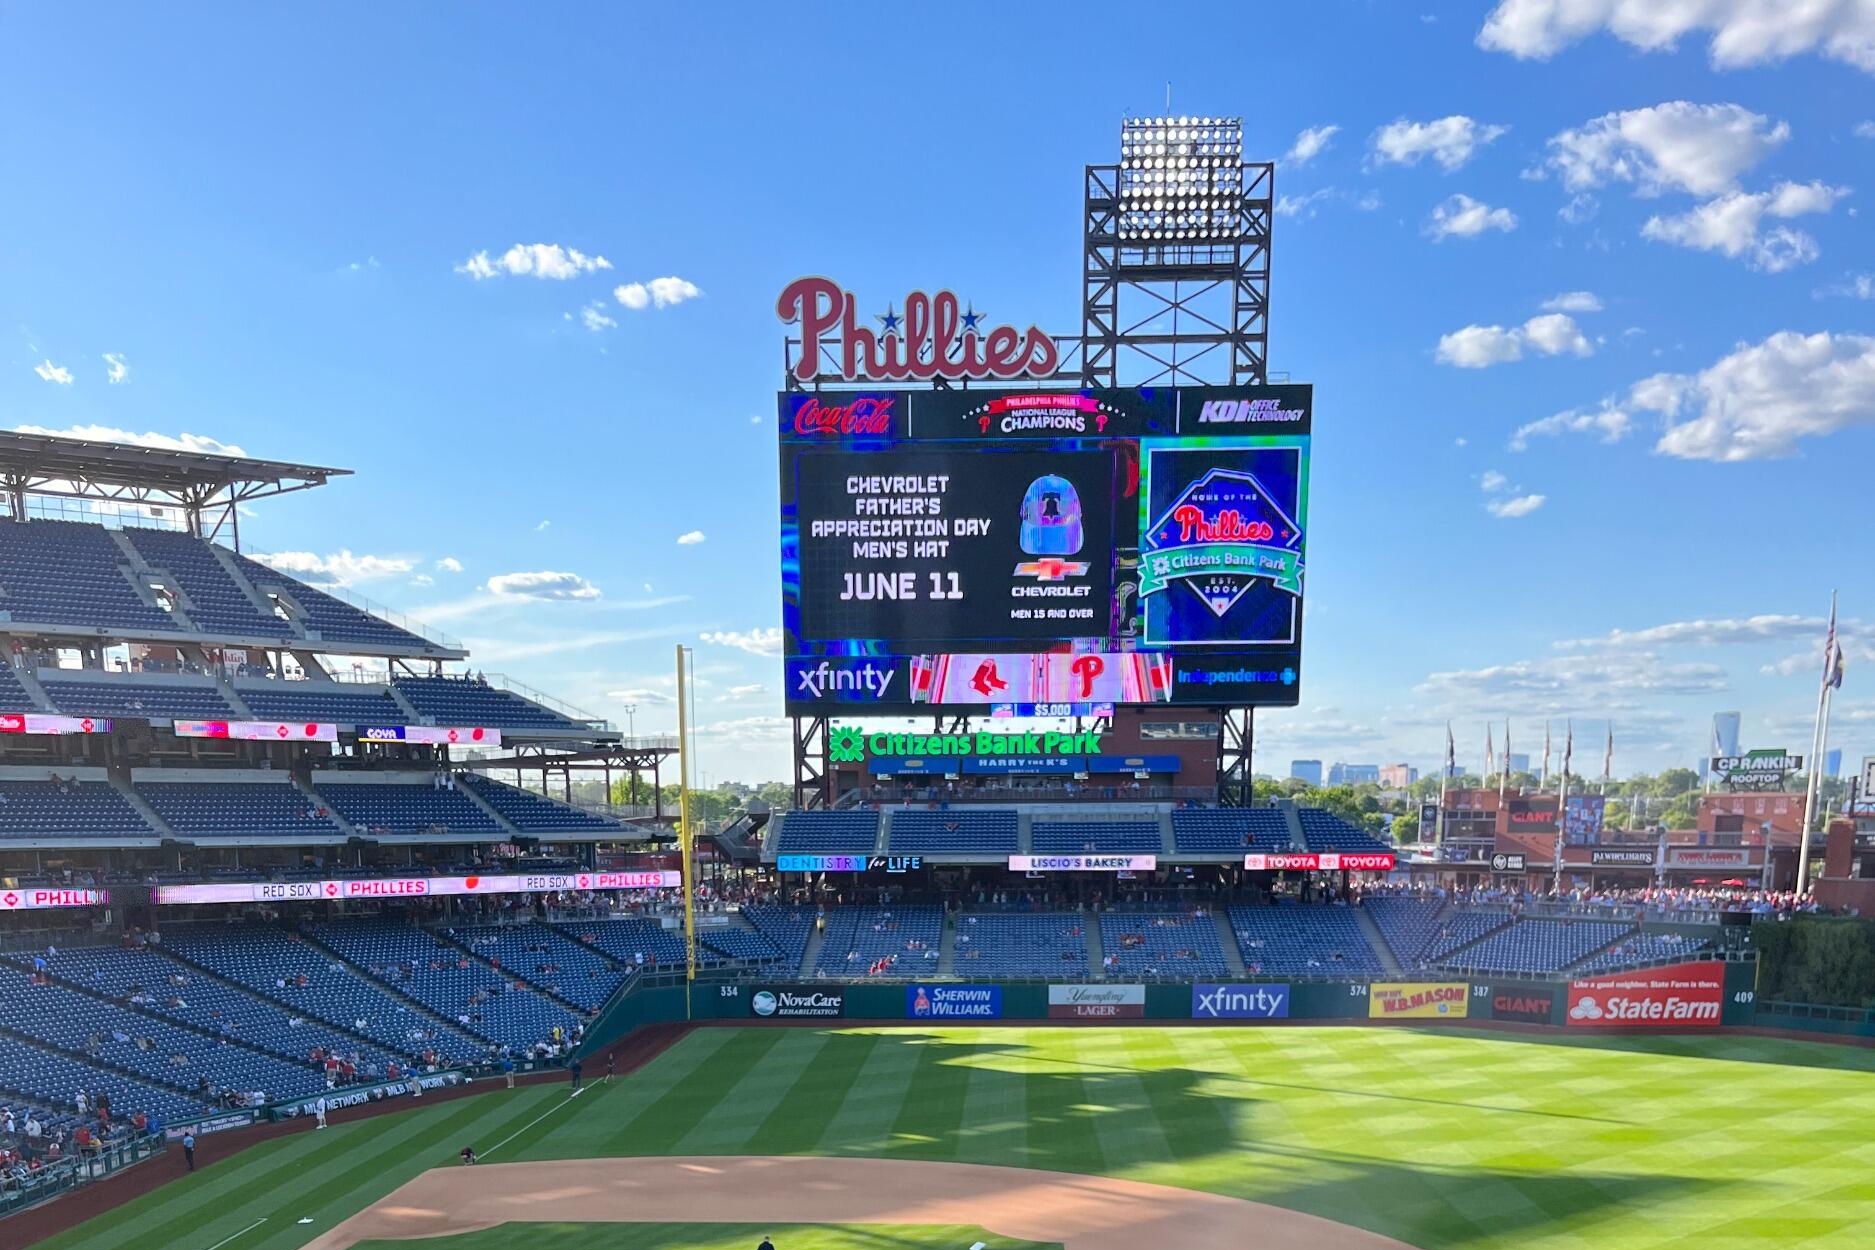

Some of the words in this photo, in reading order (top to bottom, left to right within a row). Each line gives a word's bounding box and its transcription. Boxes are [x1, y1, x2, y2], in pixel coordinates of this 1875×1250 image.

[776, 274, 1058, 381] Phillies
[1248, 399, 1281, 411] OFFICE
[1011, 408, 1048, 417] NATIONAL
[1049, 408, 1076, 416] LEAGUE
[1246, 409, 1305, 423] TECHNOLOGY
[1000, 416, 1086, 433] CHAMPIONS
[846, 476, 949, 494] CHEVROLET
[856, 498, 941, 515] FATHER'S
[811, 520, 948, 537] APPRECIATION
[954, 519, 991, 536] DAY
[1174, 504, 1274, 542] Phillies
[853, 542, 908, 558] MEN'S
[913, 541, 949, 557] HAT
[1171, 552, 1221, 568] Citizens
[1224, 552, 1255, 566] Bank
[1260, 556, 1286, 571] Park
[840, 573, 917, 600] JUNE
[929, 572, 964, 600] 11
[1011, 586, 1092, 597] CHEVROLET
[1205, 586, 1238, 594] 2004
[1011, 609, 1031, 619] MEN
[1033, 608, 1046, 619] 15
[1048, 608, 1067, 618] AND
[1069, 608, 1094, 619] OVER
[798, 662, 895, 697] xfinity
[1178, 668, 1278, 684] Independence
[367, 729, 397, 739] GOYA
[868, 731, 971, 756] Citizens
[975, 730, 1041, 755] Bank
[1044, 730, 1101, 754] Park
[978, 759, 1025, 767] HARRY
[1717, 758, 1739, 769] CP
[1740, 757, 1796, 769] RANKIN
[1730, 774, 1780, 783] ROOFTOP
[1512, 812, 1553, 822] GIANT
[780, 857, 863, 869] DENTISTRY
[888, 857, 920, 869] LIFE
[1031, 859, 1081, 868] LISCIO'S
[1085, 858, 1133, 867] BAKERY
[1267, 856, 1316, 867] TOYOTA
[1341, 856, 1391, 867] TOYOTA
[527, 878, 545, 888] RED
[549, 877, 568, 888] SOX
[599, 874, 661, 886] PHILLIES
[263, 885, 286, 897] RED
[289, 884, 313, 896] SOX
[351, 882, 425, 894] PHILLIES
[720, 986, 738, 996] 334
[932, 987, 991, 1001] SHERWIN
[1350, 985, 1367, 995] 374
[1473, 986, 1489, 996] 387
[778, 993, 842, 1006] NovaCare
[1198, 986, 1284, 1017] xfinity
[1734, 992, 1754, 1003] 409
[1494, 996, 1551, 1012] GIANT
[779, 1007, 839, 1015] REHABILITATION
[1077, 1005, 1116, 1016] LAGER
[386, 1084, 406, 1096] MLB
[326, 1091, 370, 1111] NETWORK
